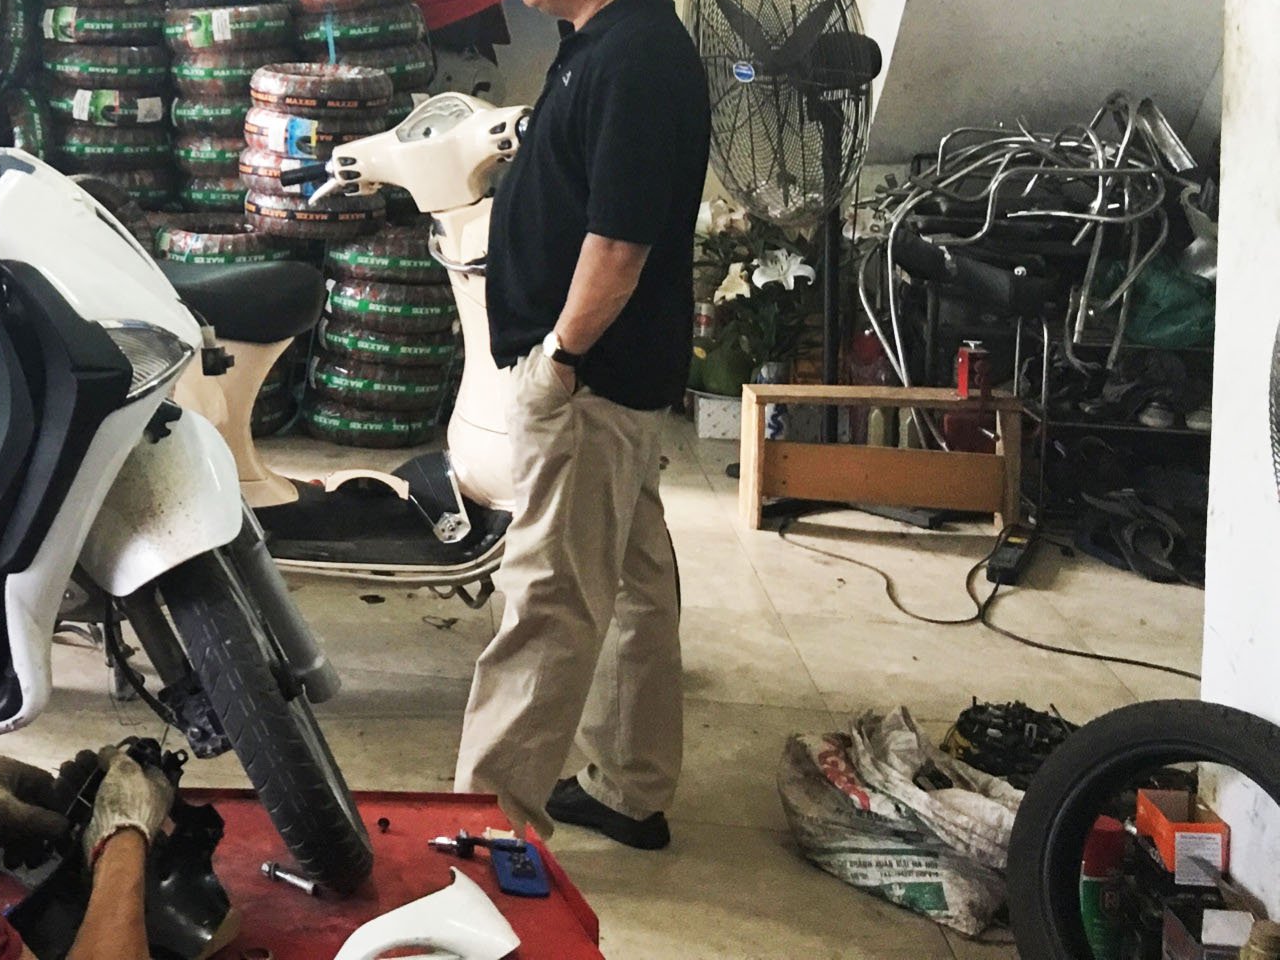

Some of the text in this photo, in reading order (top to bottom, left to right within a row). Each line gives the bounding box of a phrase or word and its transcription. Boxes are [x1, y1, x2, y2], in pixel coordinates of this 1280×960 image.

[285, 96, 317, 106] MAXXIS
[326, 100, 359, 108] MAXXIS
[294, 211, 329, 221] MAXXIS
[368, 302, 403, 314] MAXXIS
[356, 340, 391, 352] MAXXIS
